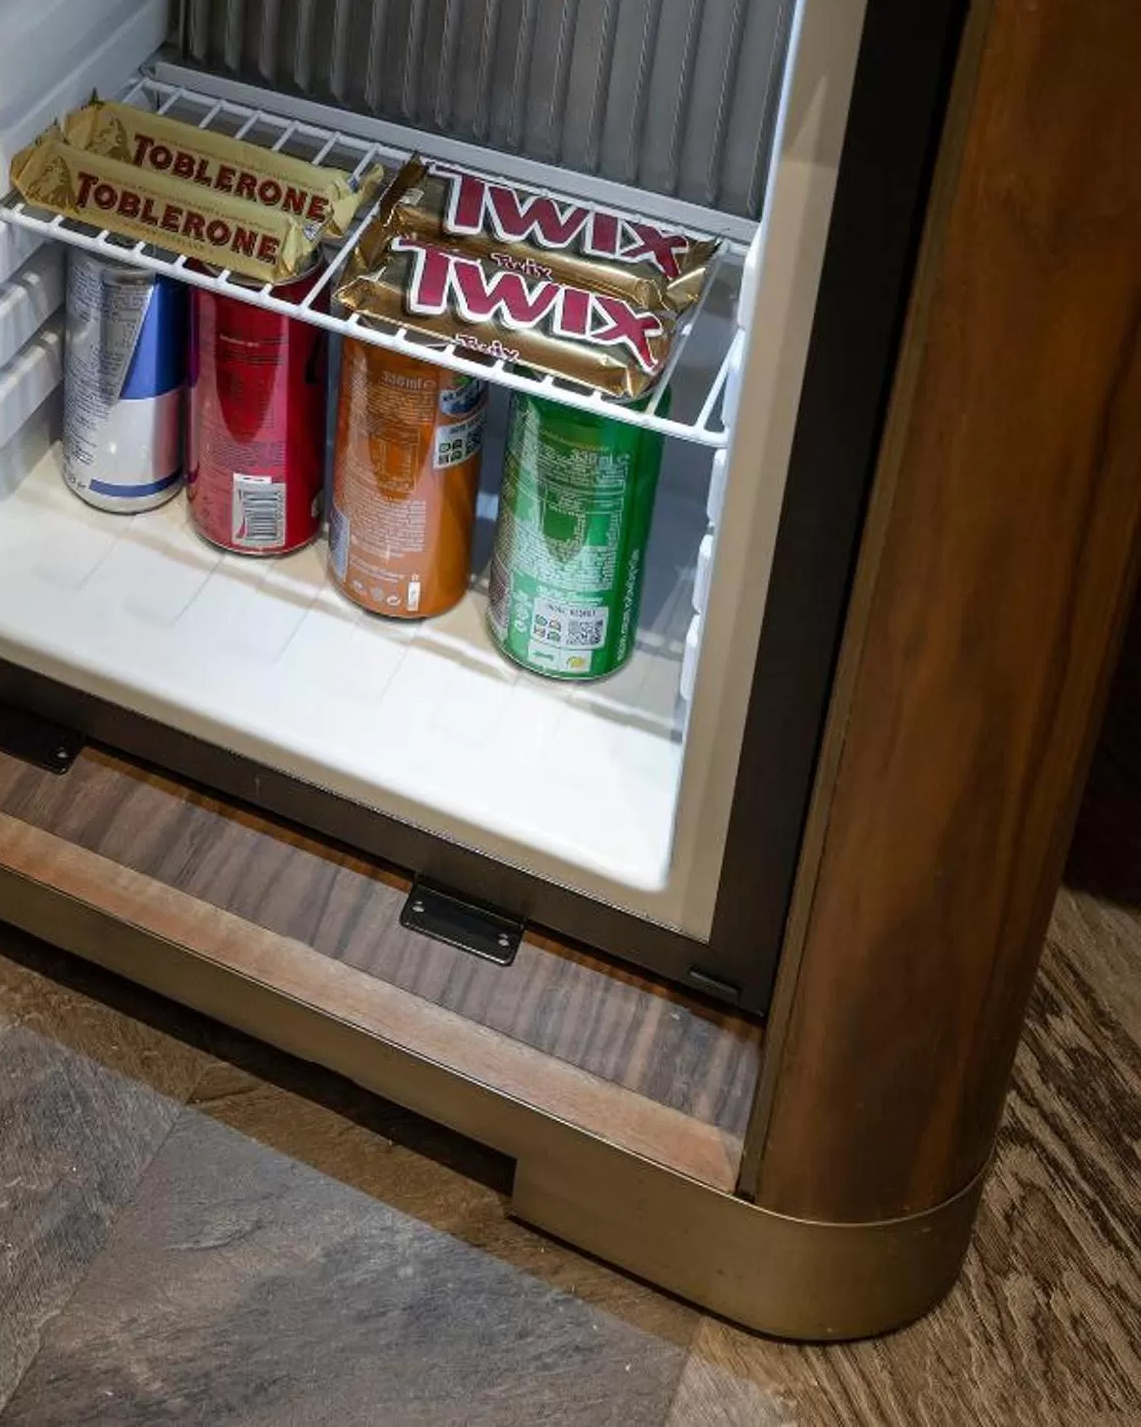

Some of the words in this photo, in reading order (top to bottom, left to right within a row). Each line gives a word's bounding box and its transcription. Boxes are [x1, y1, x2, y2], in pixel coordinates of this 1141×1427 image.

[74, 170, 282, 266] TOBLERONE
[133, 132, 330, 223] TOBLERONE
[429, 161, 689, 280] TWIX
[391, 237, 663, 375] TWIX
